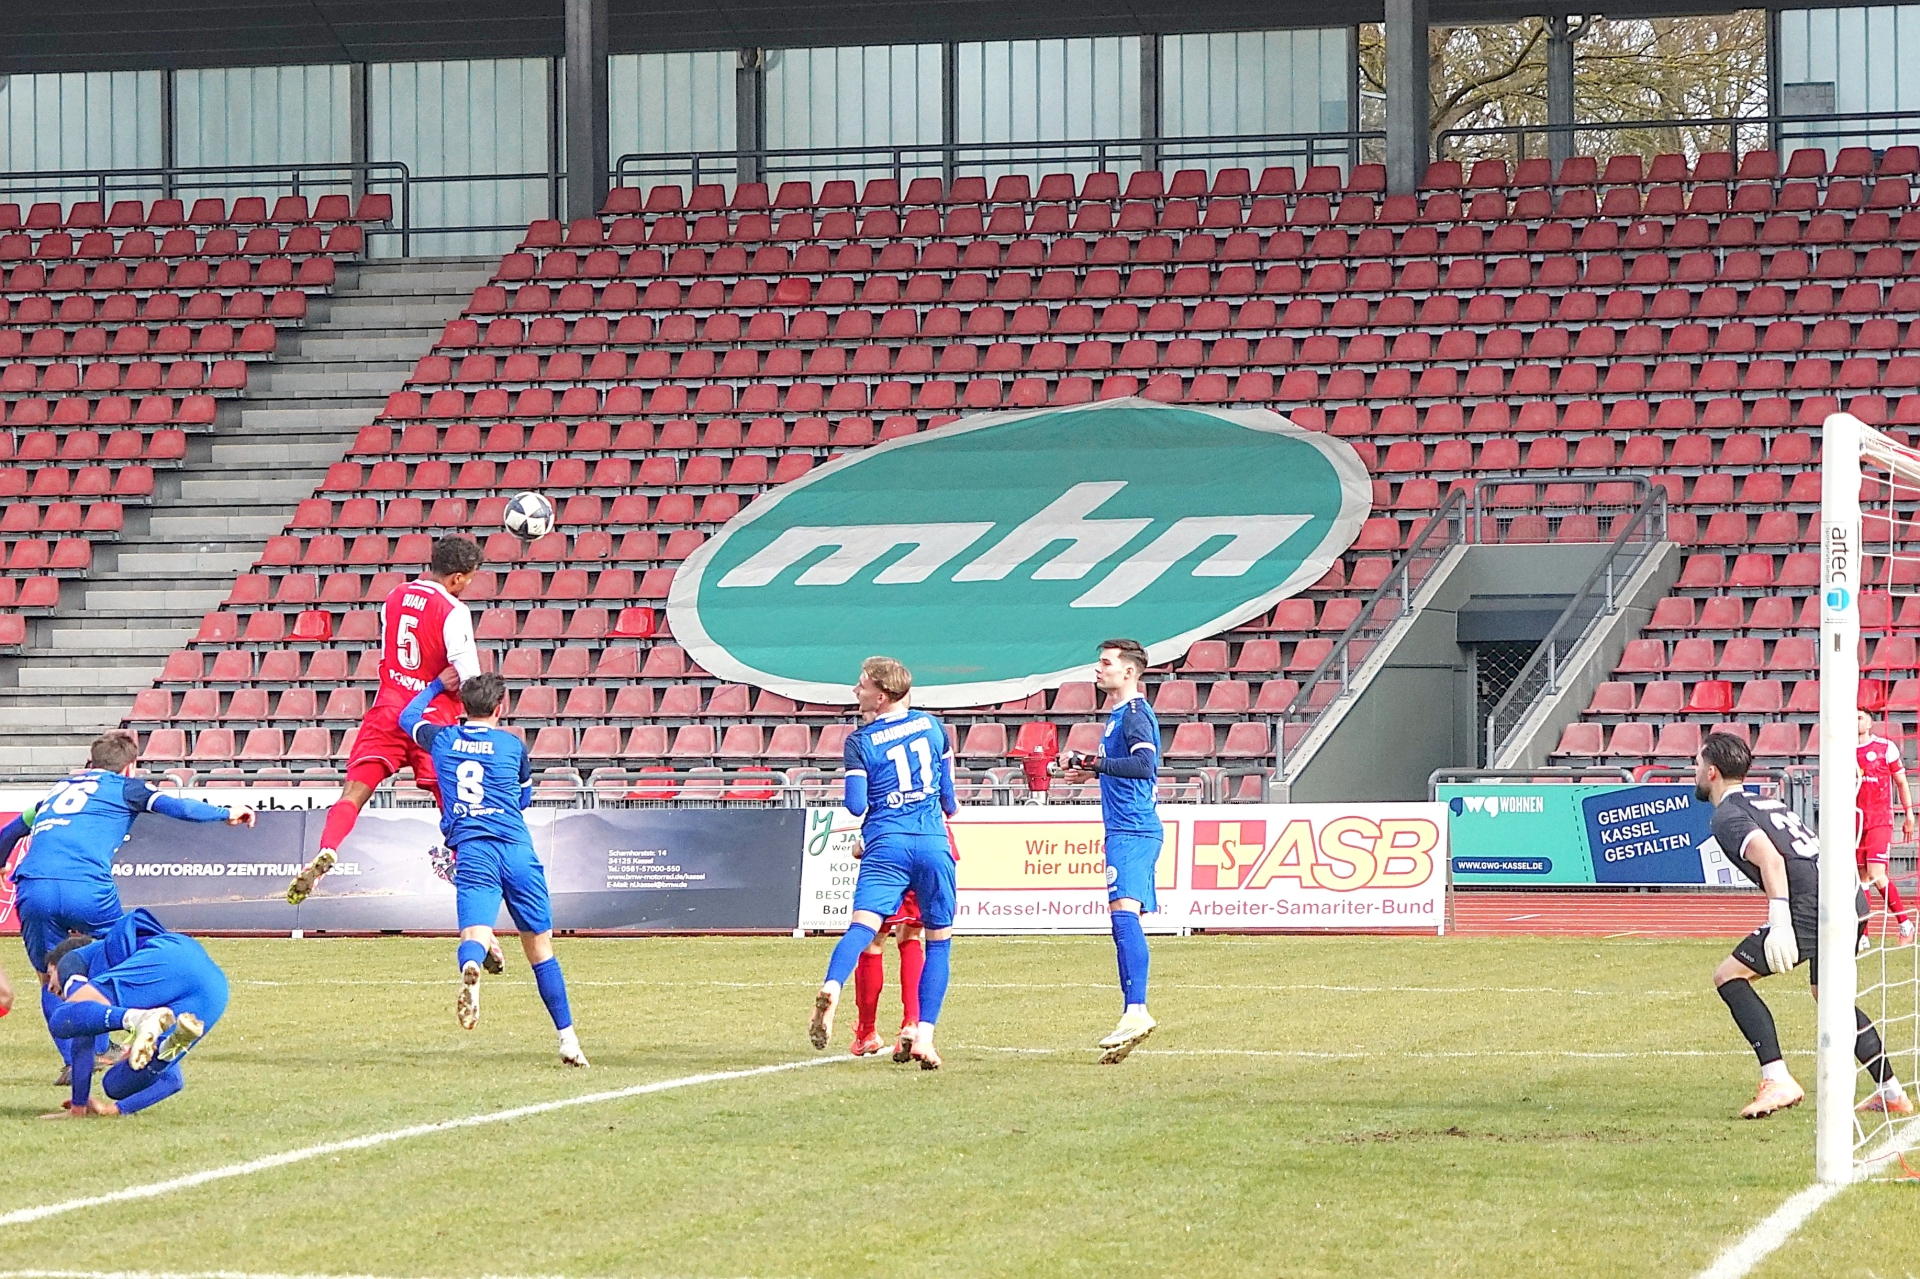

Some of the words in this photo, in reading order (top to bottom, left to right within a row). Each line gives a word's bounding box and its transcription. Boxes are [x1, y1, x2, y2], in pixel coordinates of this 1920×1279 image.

[717, 480, 1315, 608] mhp
[1831, 527, 1849, 583] artec
[397, 614, 421, 670] 5
[886, 737, 935, 794] 11
[456, 760, 485, 804] 8
[1500, 796, 1543, 813] WOHNEN
[1598, 795, 1690, 826] GEMEINSAM
[840, 833, 864, 843] JA
[1601, 821, 1659, 844] KASSEL
[657, 849, 667, 857] 14
[1025, 840, 1058, 855] Wir
[1244, 816, 1440, 892] ASB
[1604, 833, 1691, 863] GESTALTEN
[111, 863, 134, 876] AG
[135, 863, 226, 876] MOTORRAD
[226, 863, 301, 876] ZENTRUM
[304, 863, 362, 876] SSEL
[1024, 860, 1061, 875] hier
[1068, 860, 1105, 875] und
[1458, 861, 1543, 870] WWW.GWG-KASSEL.DE
[823, 905, 848, 915] Bad
[1189, 899, 1434, 916] Arbeiter-Samariter-Bund
[1739, 949, 1755, 963] JAKO
